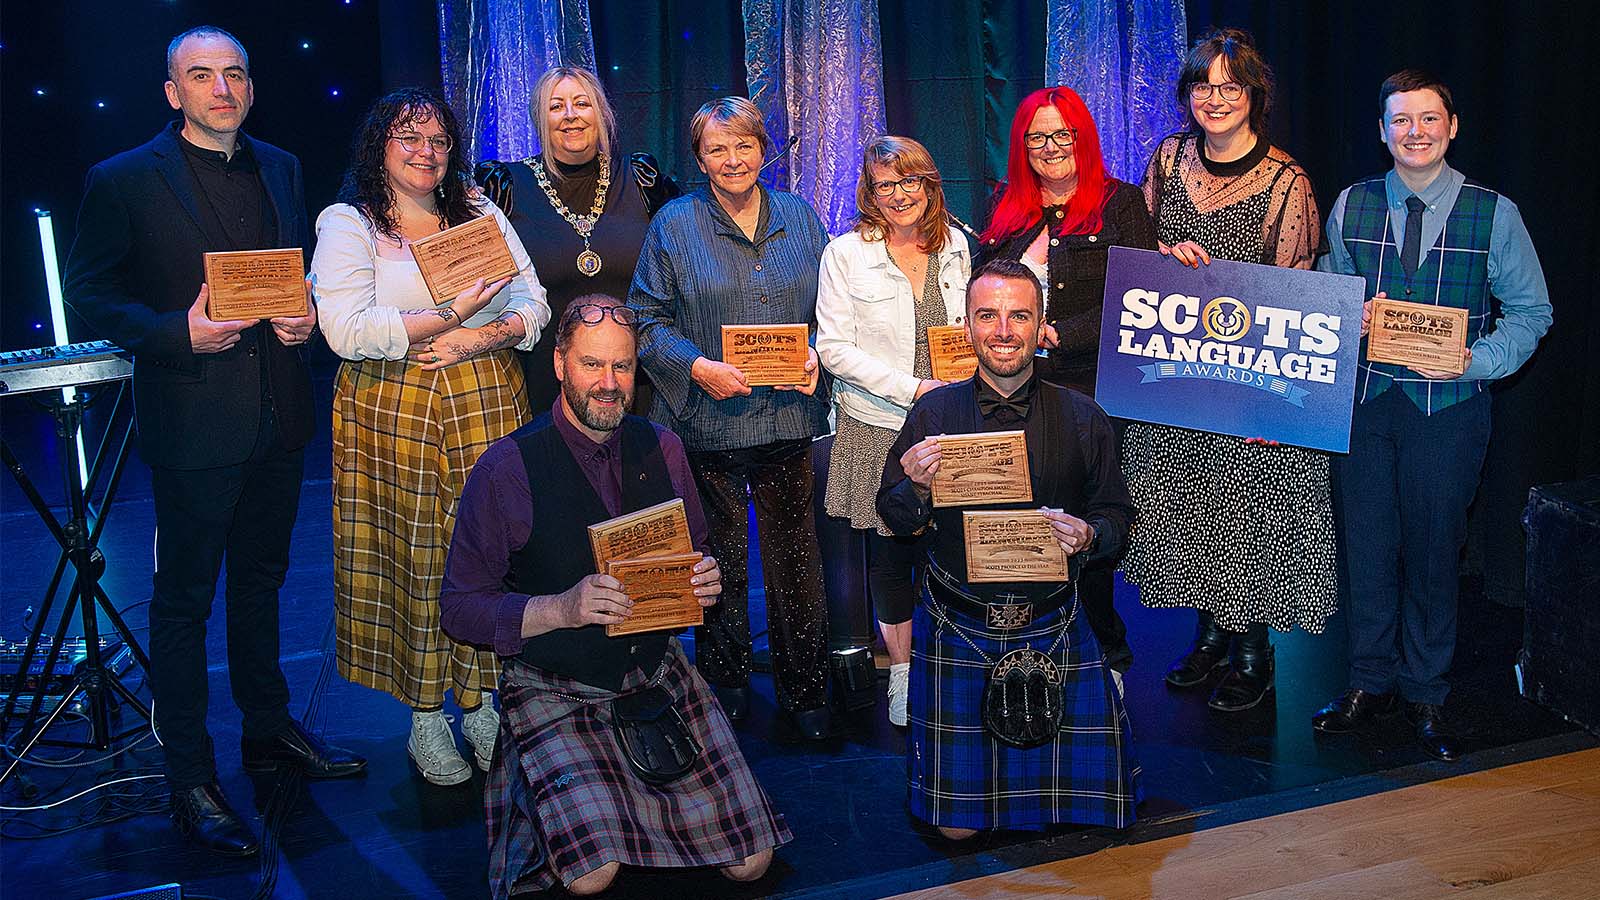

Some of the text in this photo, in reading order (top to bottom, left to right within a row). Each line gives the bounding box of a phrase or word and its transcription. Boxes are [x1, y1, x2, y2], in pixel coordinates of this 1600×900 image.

[1119, 288, 1341, 355] SCOTS
[1383, 322, 1452, 338] LANGUAGE
[1117, 329, 1337, 384] LANGUAGE
[1182, 363, 1265, 386] AWARDS
